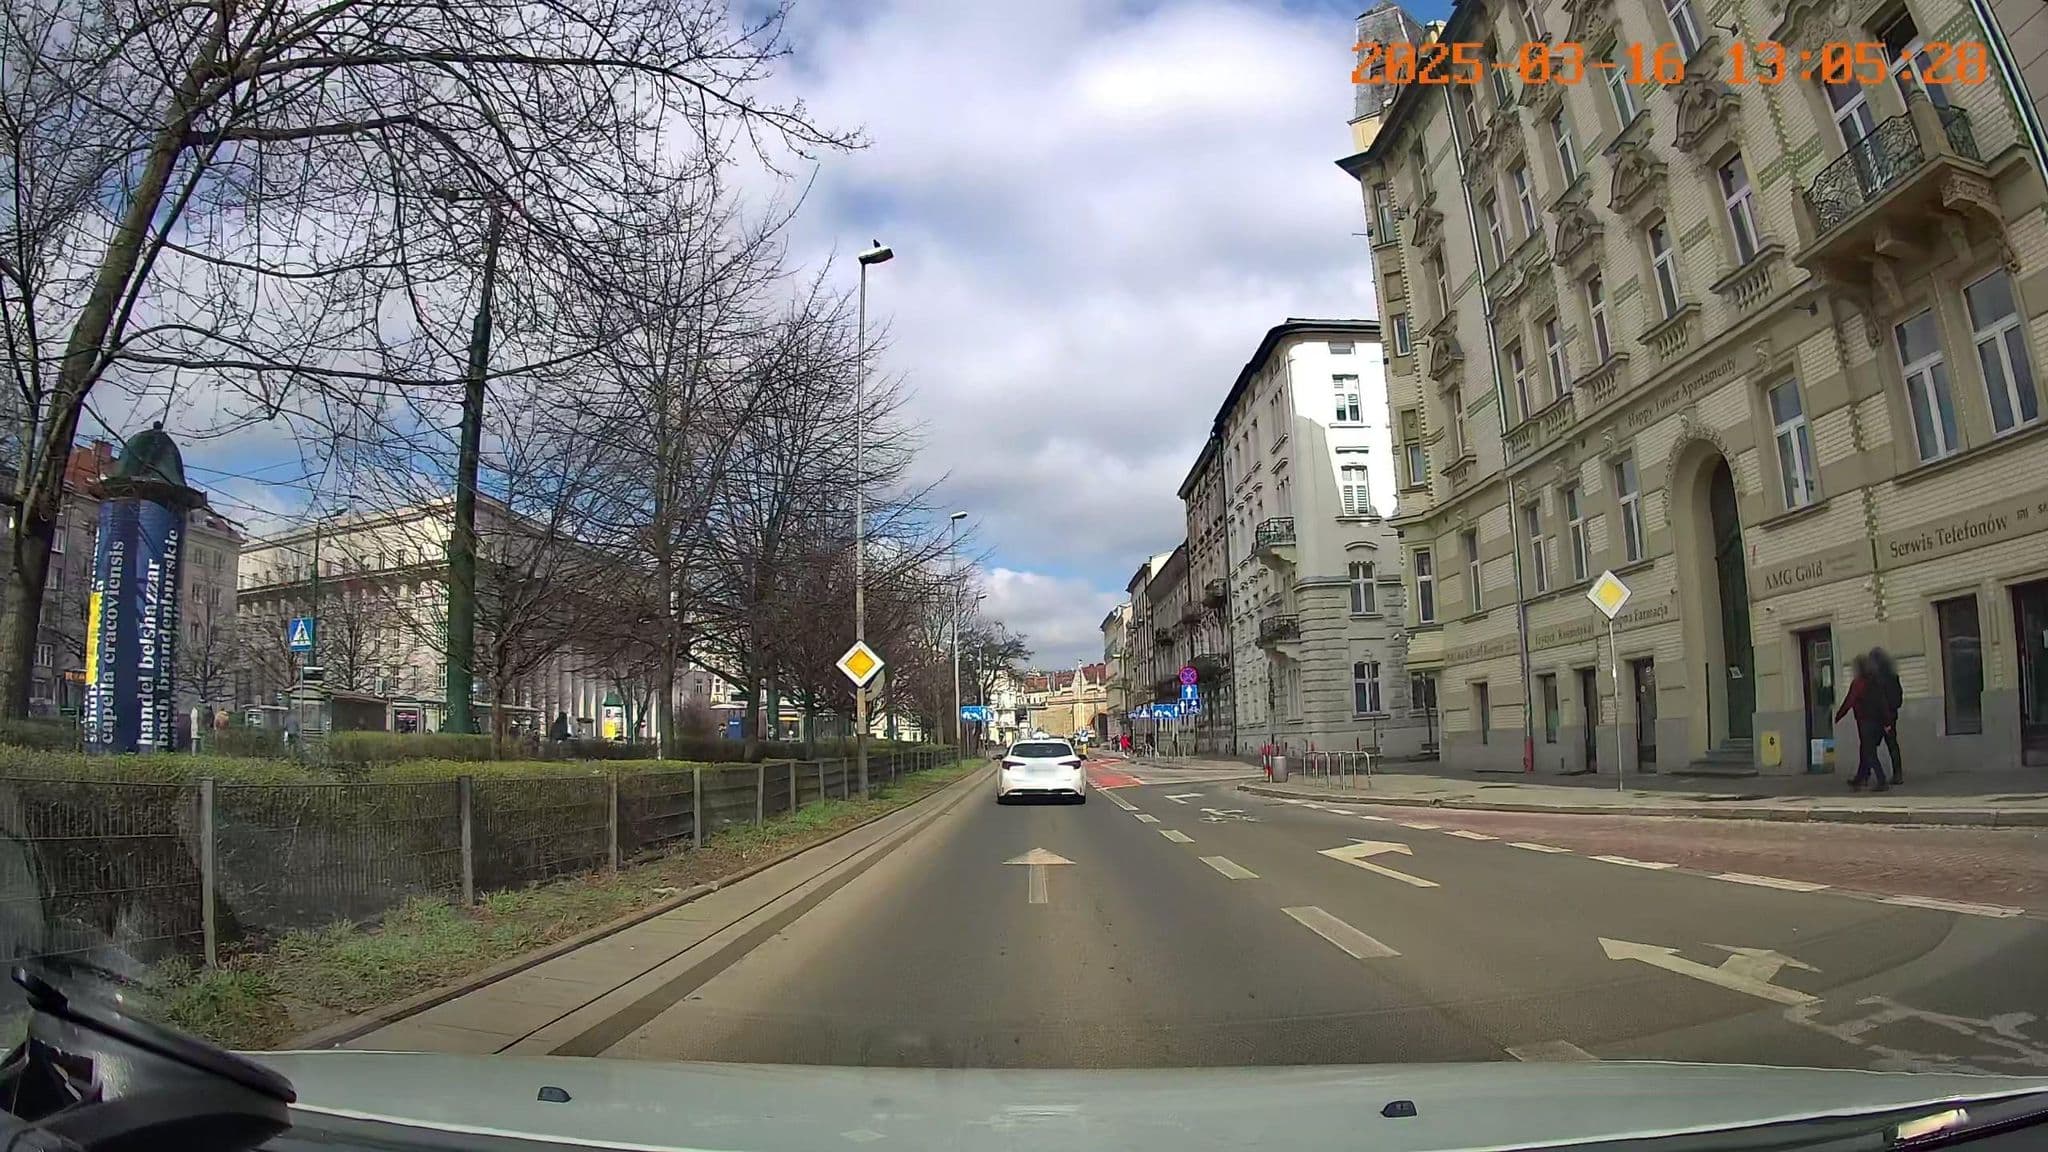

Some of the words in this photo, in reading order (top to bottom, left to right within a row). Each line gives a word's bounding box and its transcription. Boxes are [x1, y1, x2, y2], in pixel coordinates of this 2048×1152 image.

[1680, 356, 1737, 398] Apartamenty
[1889, 533, 1933, 558] Serwis
[1935, 513, 2007, 546] Telefonów
[104, 541, 124, 664] cracoviensis
[1765, 568, 1792, 590] AMG
[1795, 560, 1823, 582] Gold
[137, 558, 160, 669] belshazzar
[157, 530, 178, 691] brandenburskie
[100, 671, 118, 744] capella
[136, 675, 154, 745] handel
[156, 698, 169, 746] bach
